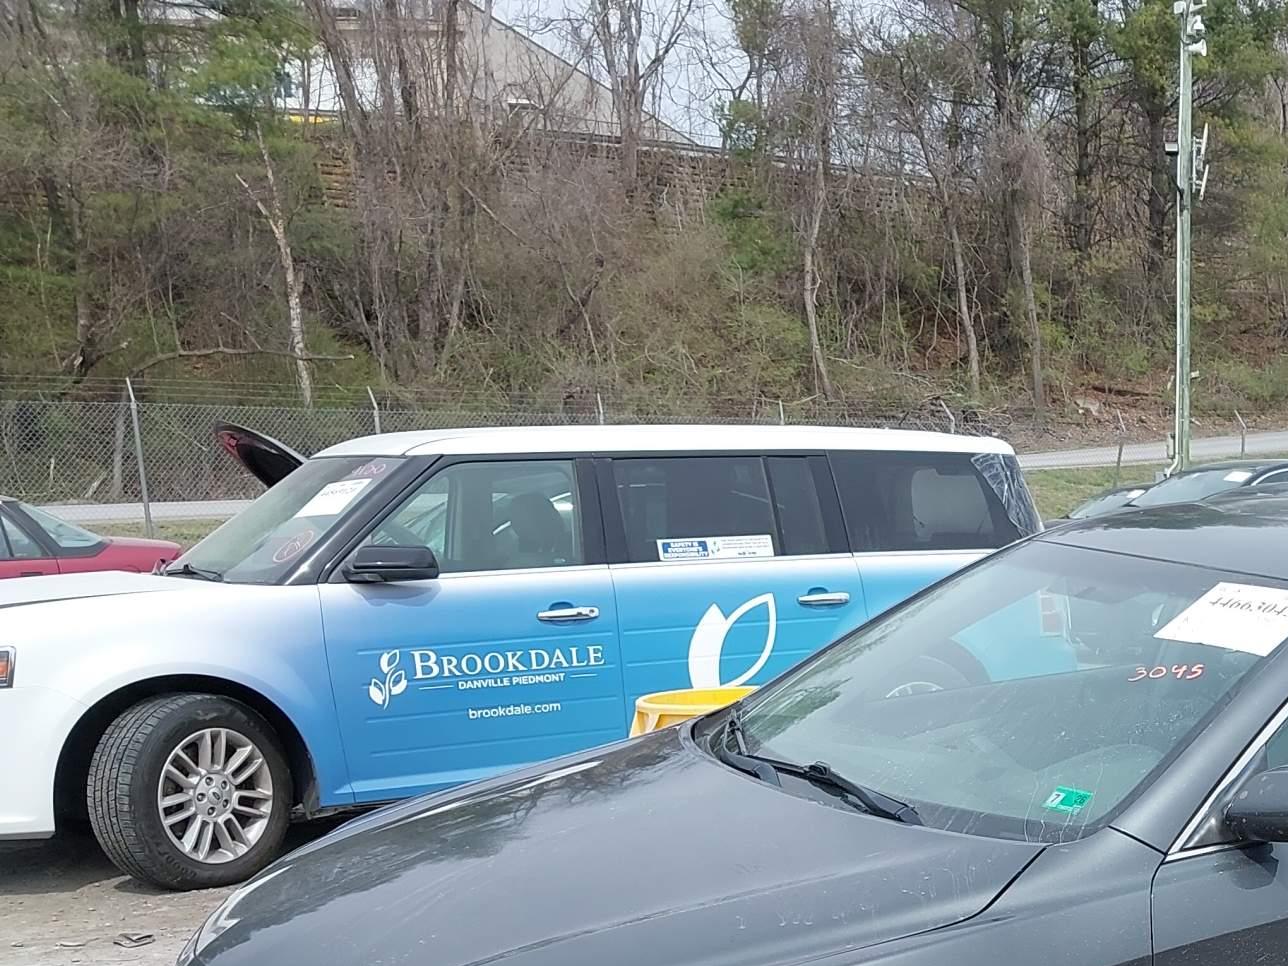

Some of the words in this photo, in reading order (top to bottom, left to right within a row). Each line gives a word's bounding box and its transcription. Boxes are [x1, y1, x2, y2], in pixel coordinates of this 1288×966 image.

[410, 645, 606, 680] BROOKDALE
[457, 677, 511, 690] DANVILLE
[512, 672, 566, 686] PIEDMONT
[1127, 663, 1207, 683] 3045
[467, 701, 562, 720] brookdale.com
